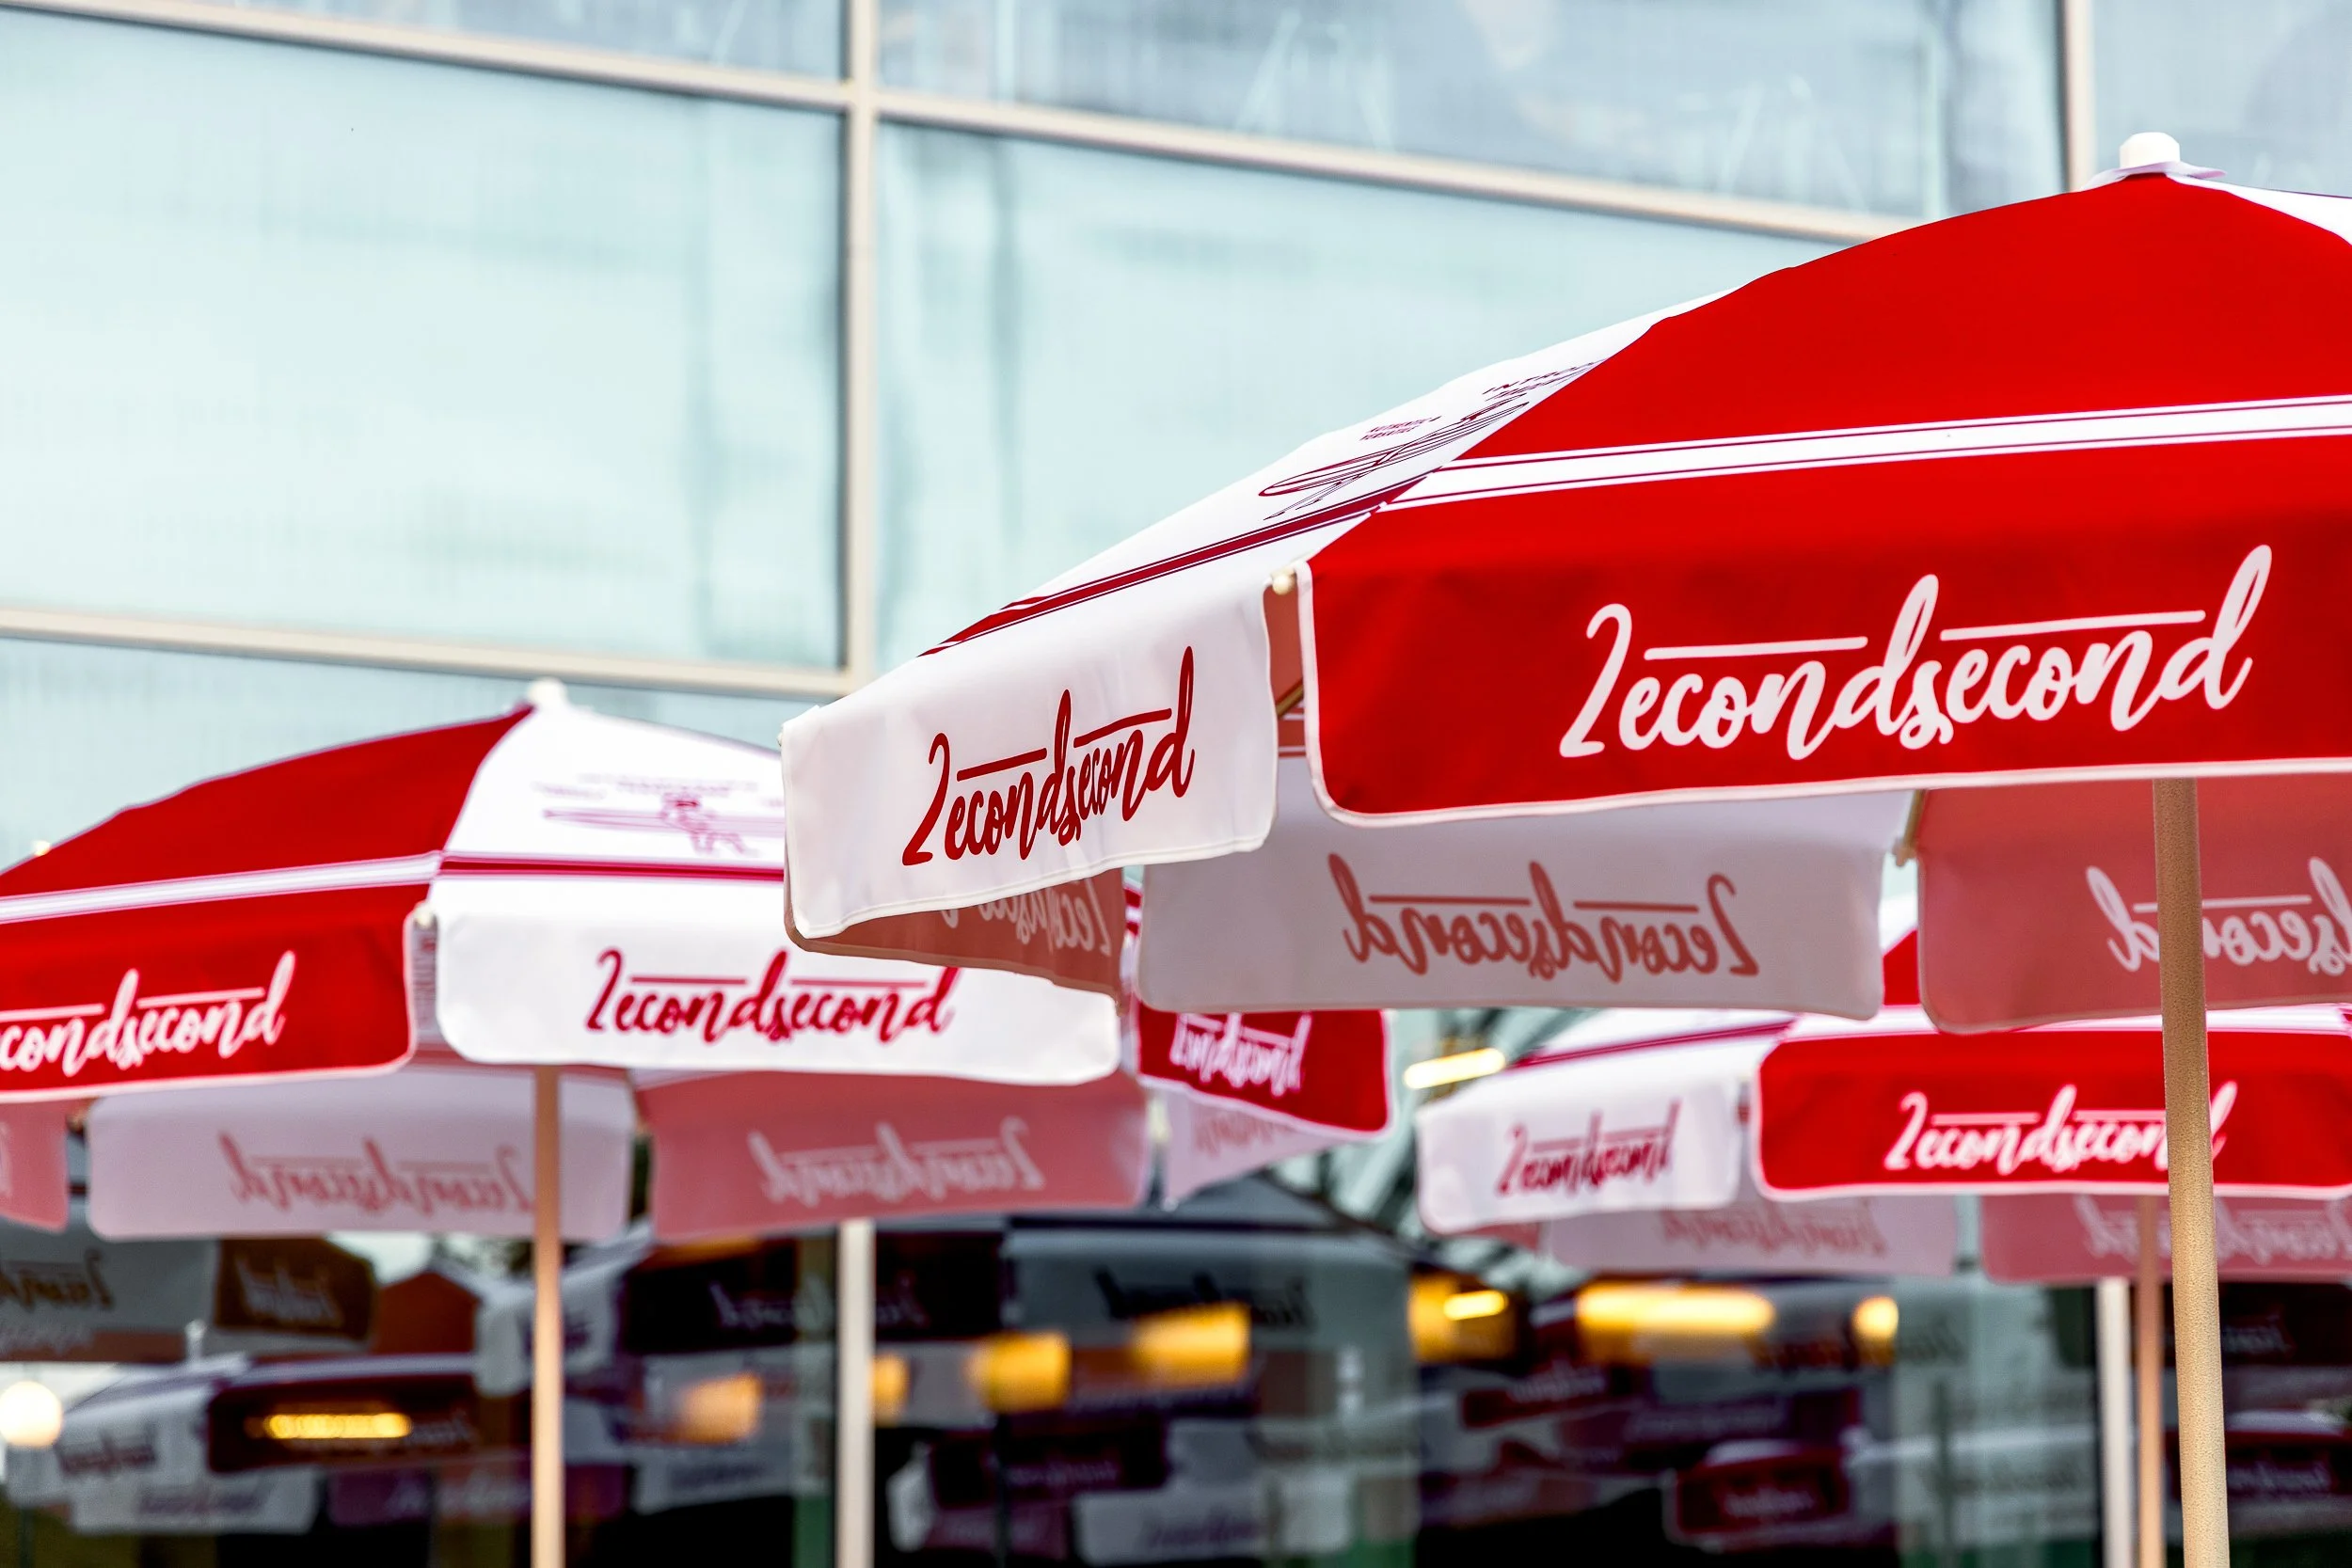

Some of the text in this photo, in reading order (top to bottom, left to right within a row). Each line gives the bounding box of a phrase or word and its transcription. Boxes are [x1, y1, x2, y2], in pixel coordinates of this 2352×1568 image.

[901, 646, 1195, 866] 2econdsecond
[1560, 544, 2272, 759] 2econdsecond
[584, 947, 960, 1042] 2econdsecond
